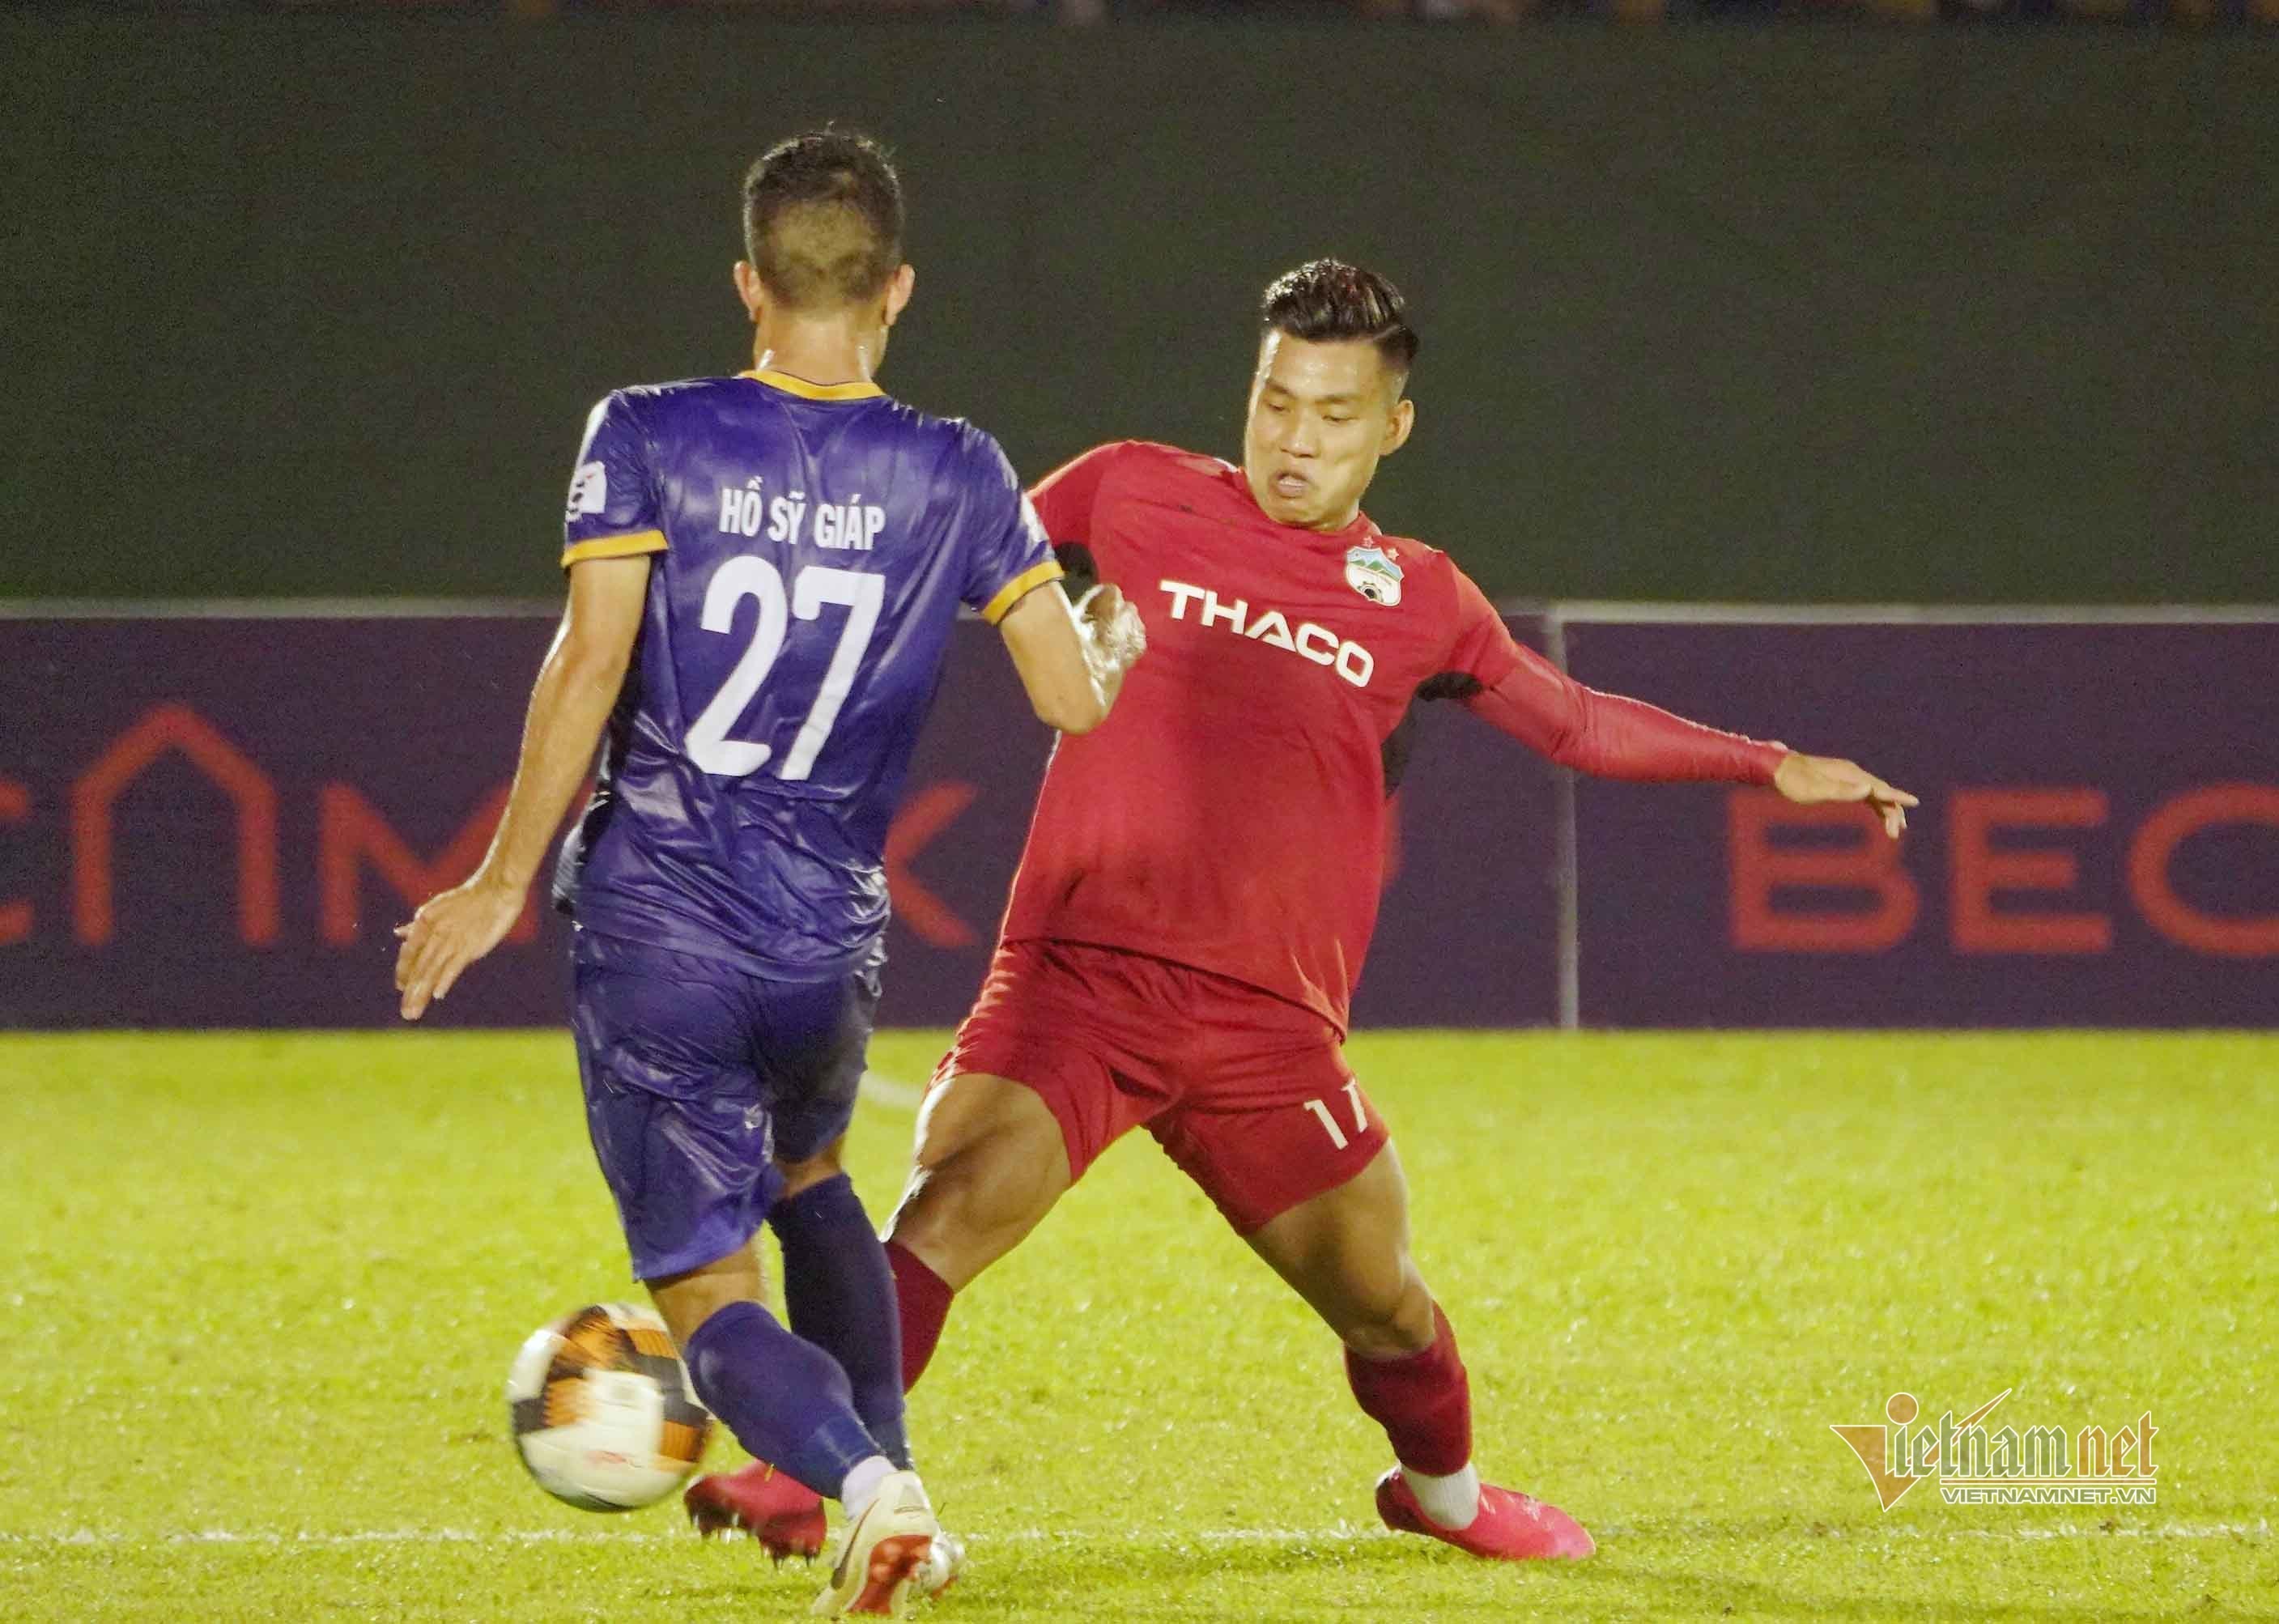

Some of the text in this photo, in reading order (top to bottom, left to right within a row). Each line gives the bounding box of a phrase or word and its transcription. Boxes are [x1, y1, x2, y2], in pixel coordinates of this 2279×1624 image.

[718, 475, 887, 551] HỒ SỸ GIÁP
[685, 555, 886, 781] 27
[1159, 579, 1375, 688] THACO
